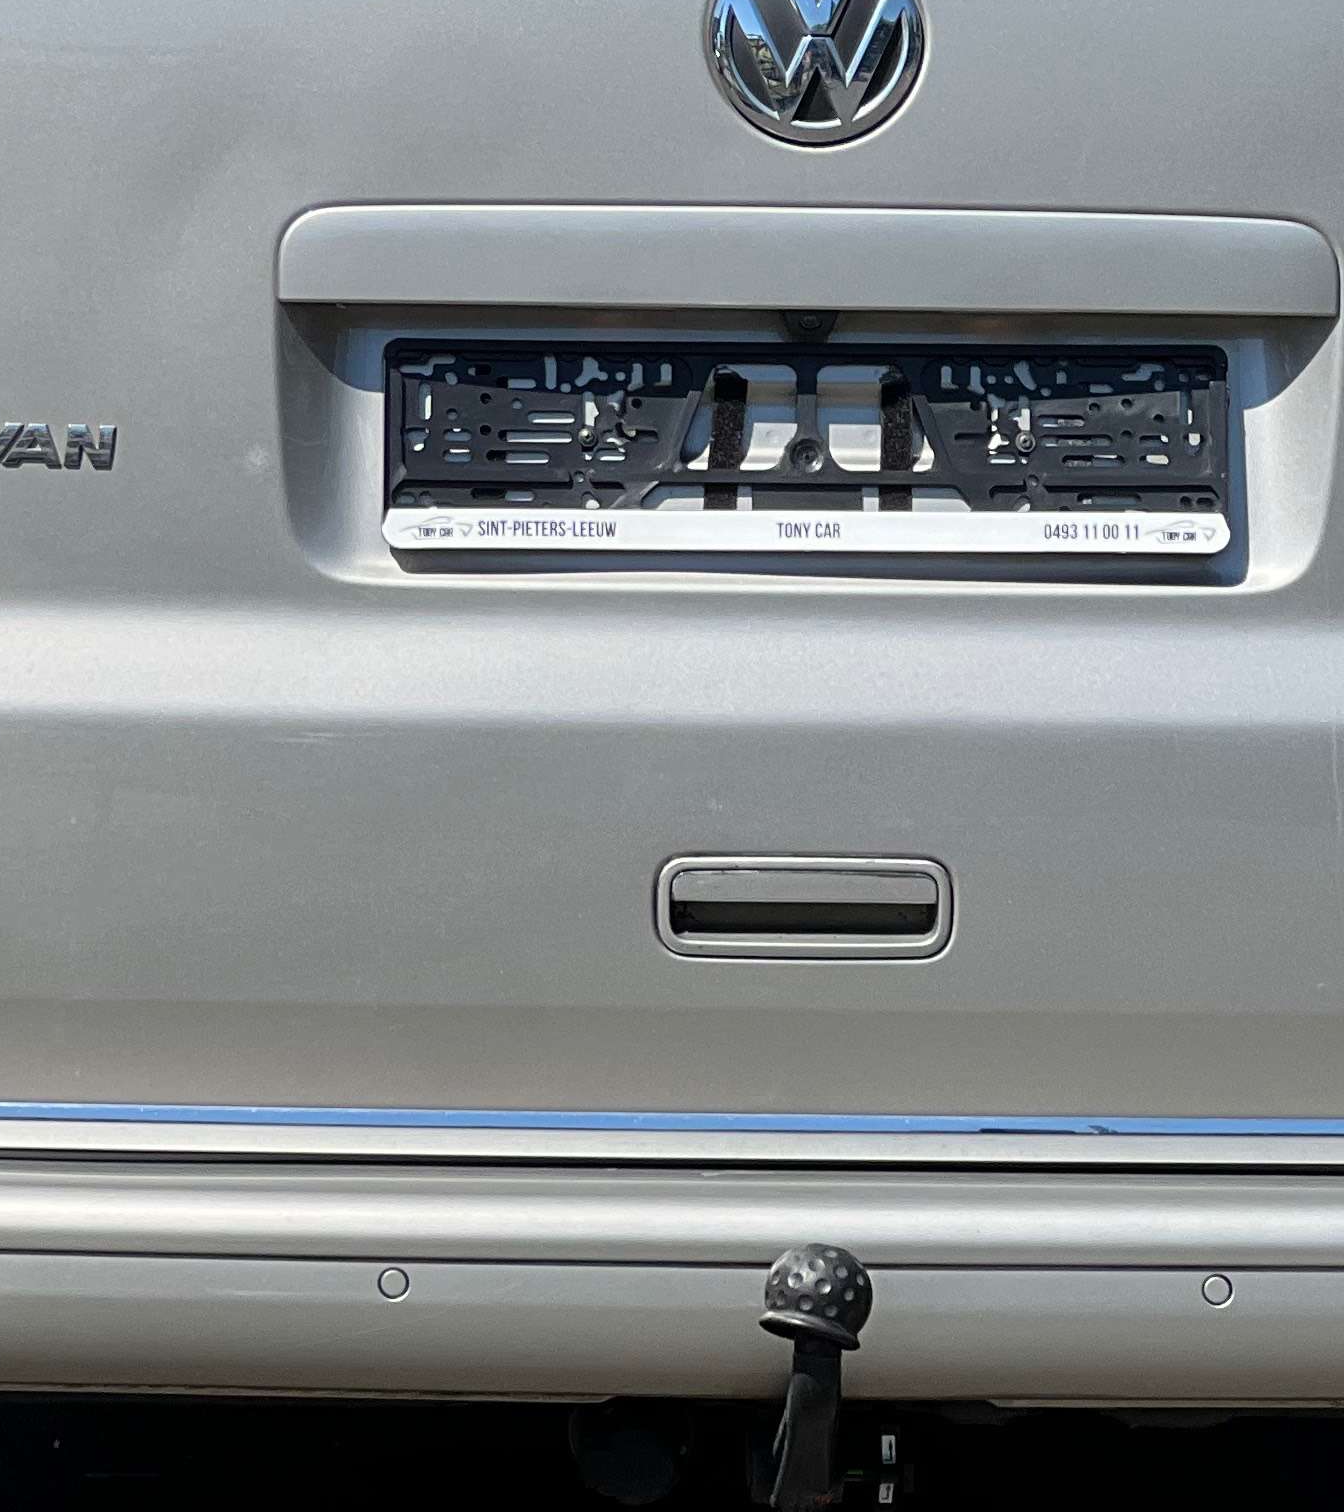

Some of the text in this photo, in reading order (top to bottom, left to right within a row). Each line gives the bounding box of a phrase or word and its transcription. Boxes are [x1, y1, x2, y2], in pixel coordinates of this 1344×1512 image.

[478, 520, 617, 538] SINT-PIETERS-LEEUW
[776, 521, 841, 539] TONY CAR
[1044, 523, 1140, 540] 0493 11 00 11
